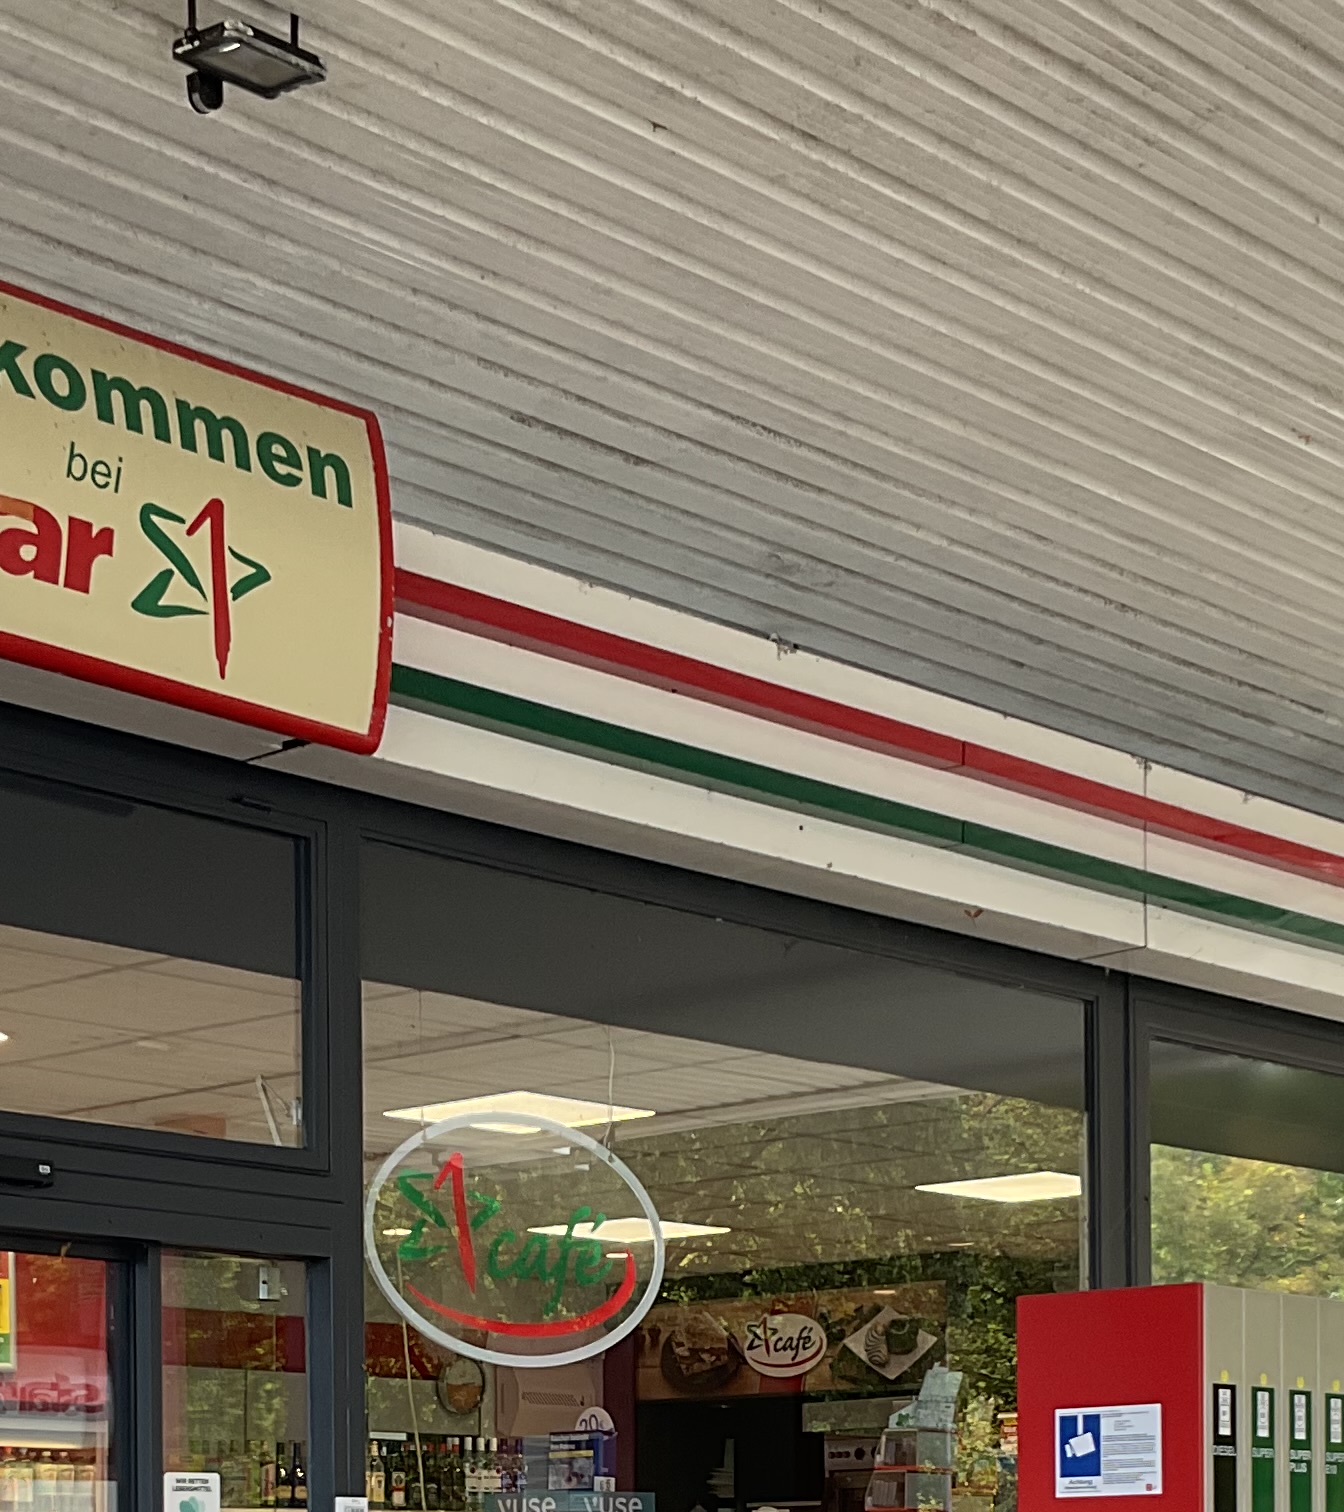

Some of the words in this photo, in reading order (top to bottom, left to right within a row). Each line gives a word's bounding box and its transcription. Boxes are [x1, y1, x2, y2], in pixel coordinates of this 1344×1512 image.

[65, 441, 124, 495] bei
[487, 1205, 613, 1317] café
[773, 1326, 817, 1361] café
